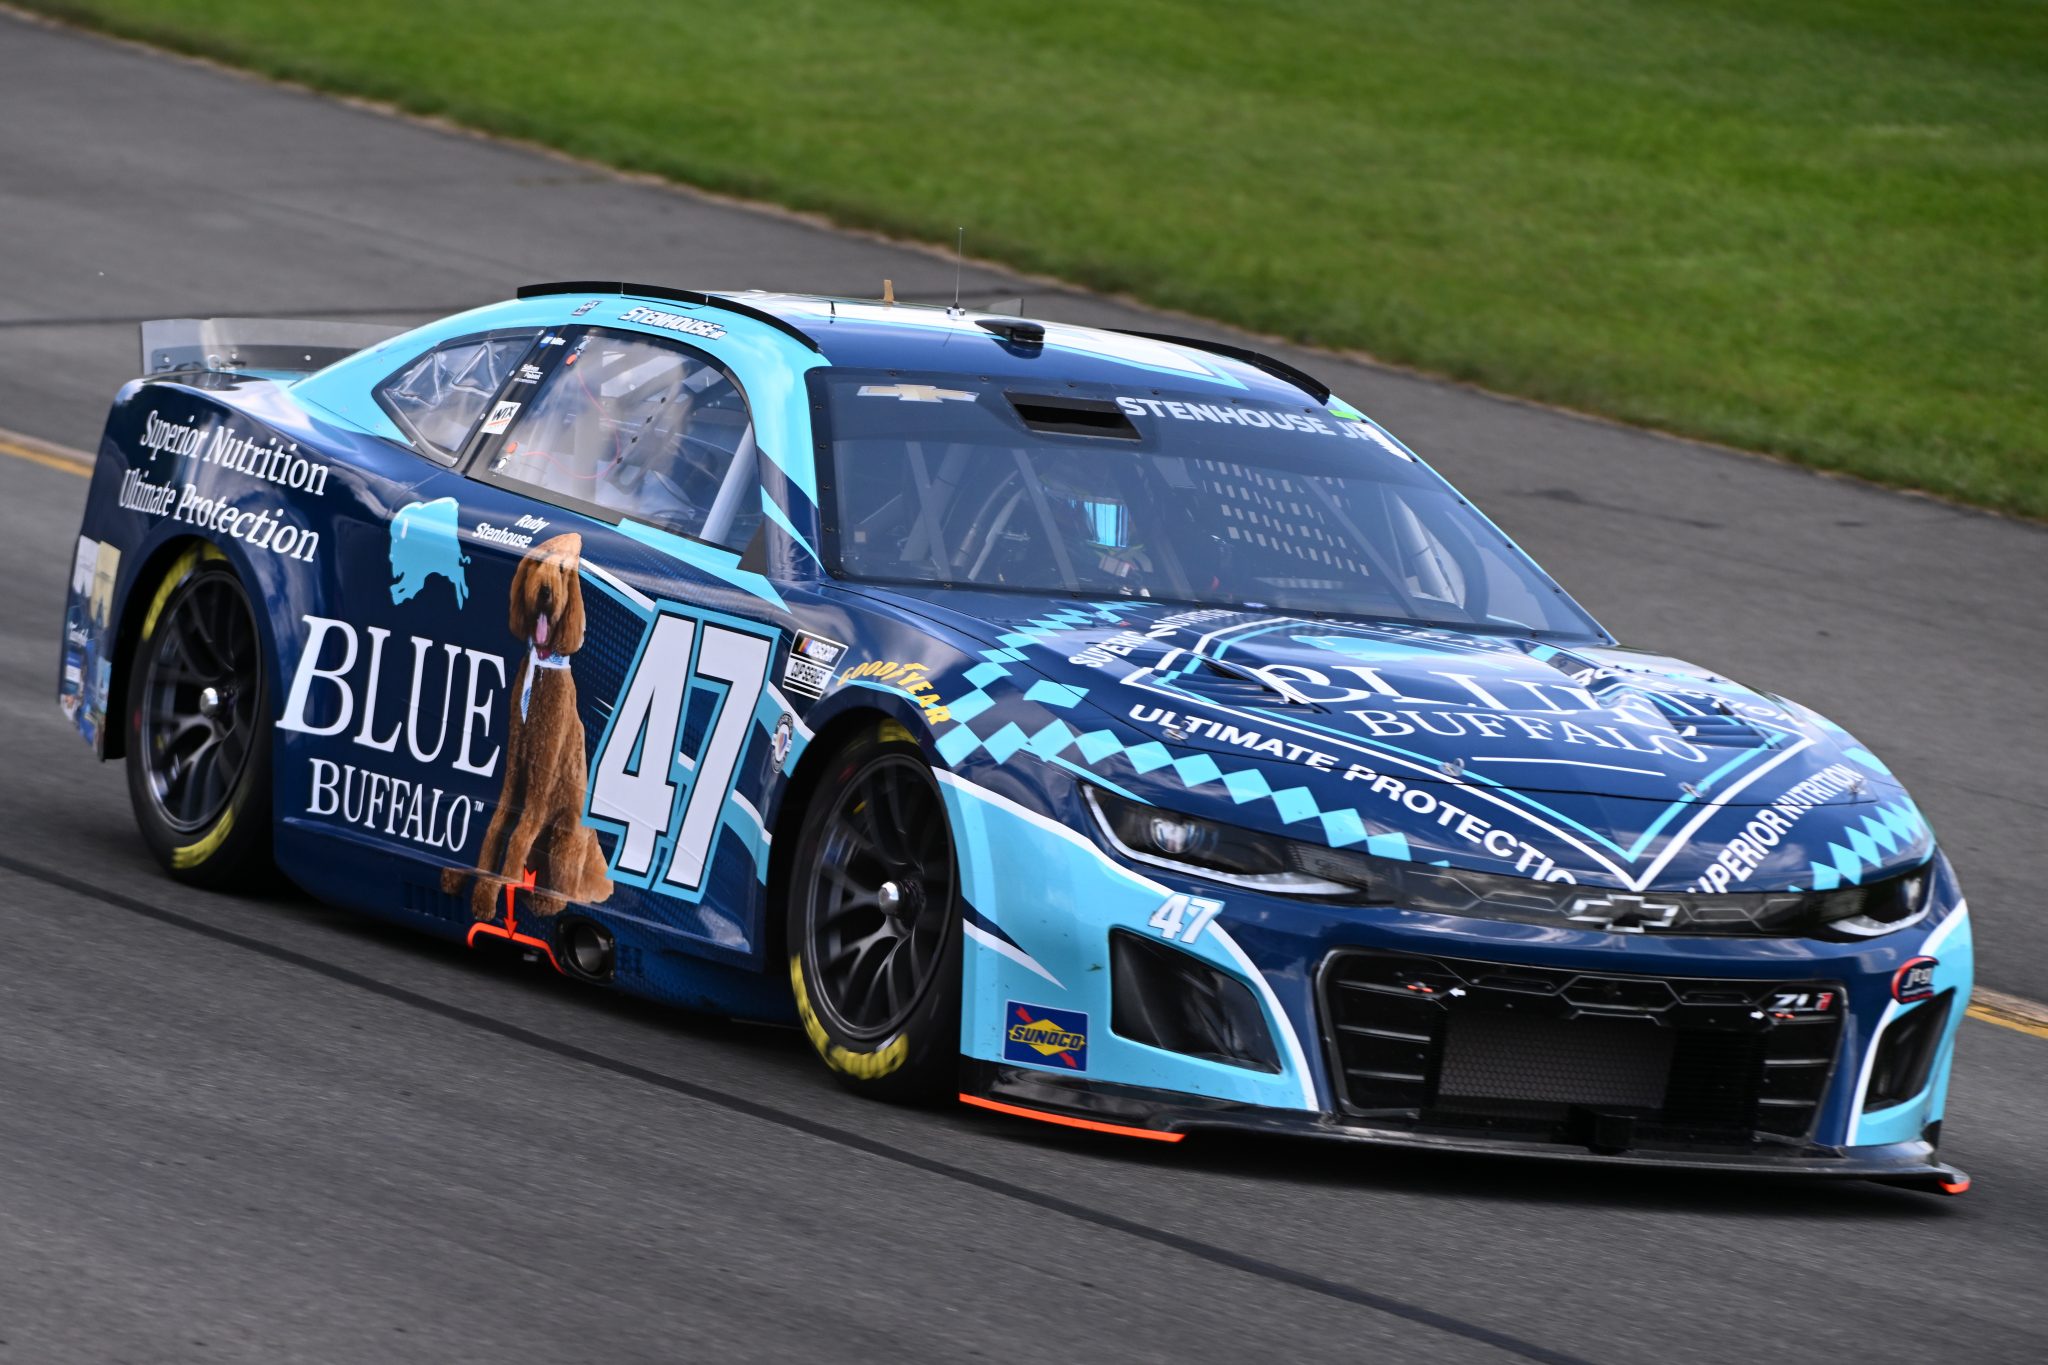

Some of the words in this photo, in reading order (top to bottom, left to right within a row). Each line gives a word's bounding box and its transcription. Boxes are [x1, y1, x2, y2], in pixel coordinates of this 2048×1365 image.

[618, 306, 723, 338] STENHOUSE
[492, 405, 517, 421] WIX
[1115, 396, 1336, 436] STENHOUSE
[139, 410, 209, 461] Superior
[202, 425, 329, 496] Nutrition
[118, 467, 177, 517] Ultimate
[173, 483, 320, 563] Protection
[472, 522, 533, 549] Stenhouse
[514, 514, 551, 535] Ruby
[275, 614, 506, 778] BLUE
[586, 609, 773, 892] 47
[1128, 704, 1336, 773] ULTIMATE
[1344, 709, 1708, 763] BUFFALO
[1771, 763, 1865, 821] NUTRITION
[1148, 892, 1224, 944] 47
[1767, 992, 1834, 1012] ZL1
[1012, 1026, 1082, 1049] SUNOCO
